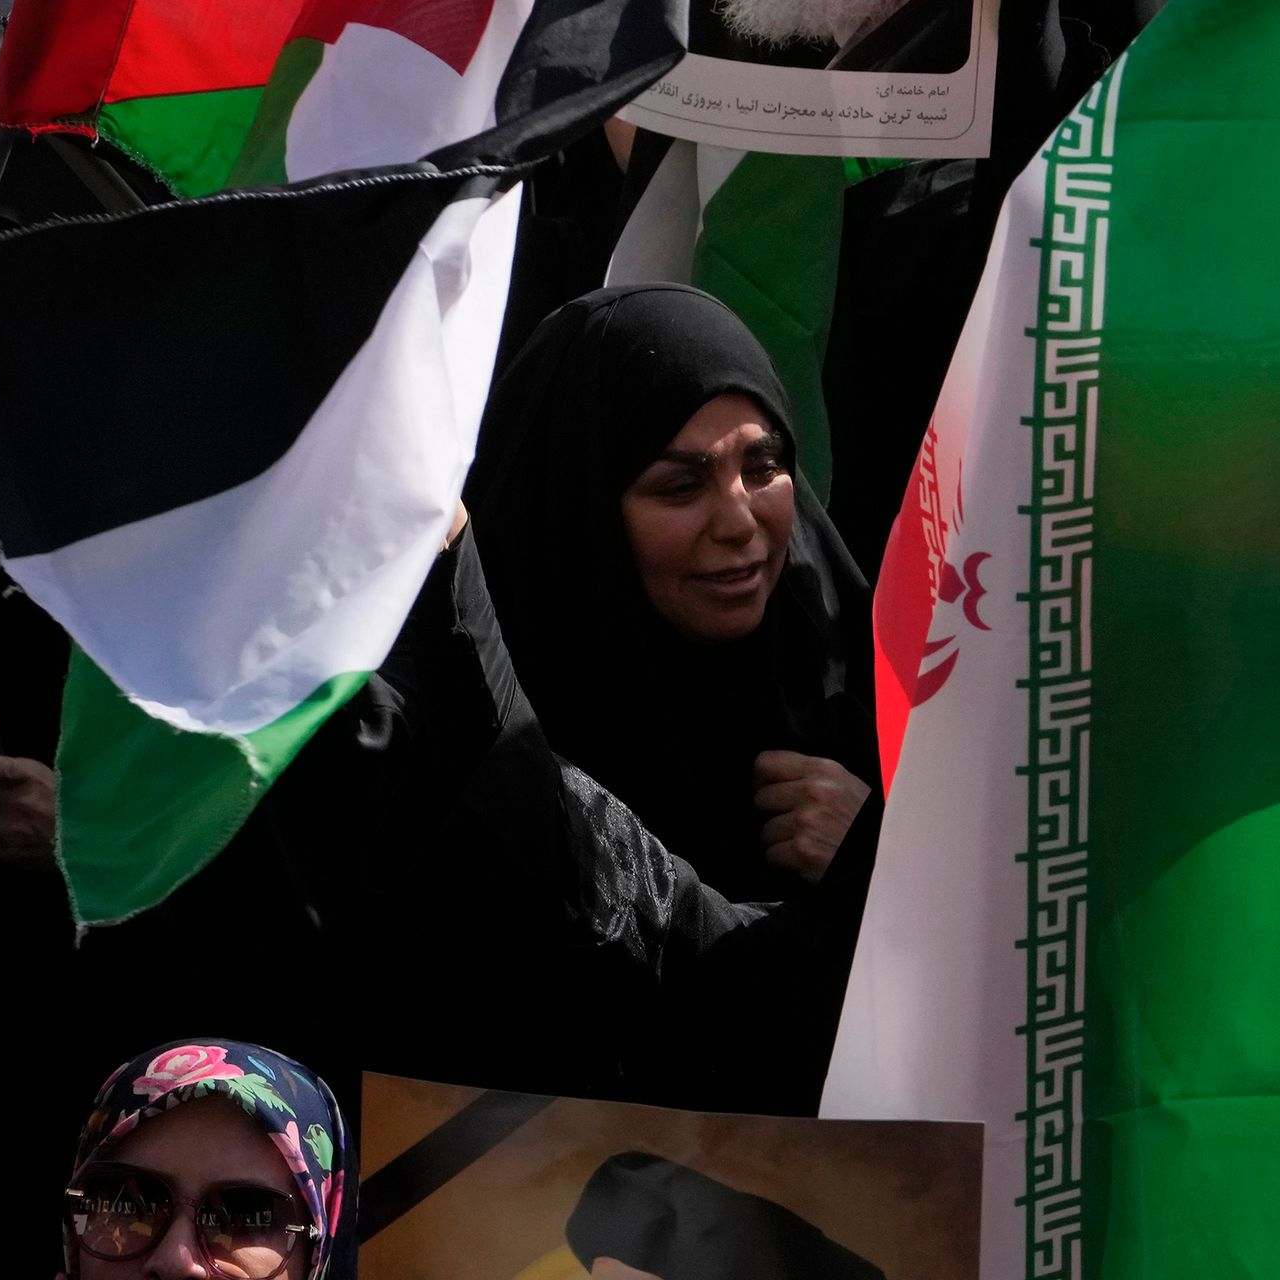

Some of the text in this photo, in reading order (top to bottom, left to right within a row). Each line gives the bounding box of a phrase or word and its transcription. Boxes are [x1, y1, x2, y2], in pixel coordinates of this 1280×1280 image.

[896, 85, 925, 97] خامنه
[928, 86, 950, 100] امام
[762, 102, 816, 121] معجزات
